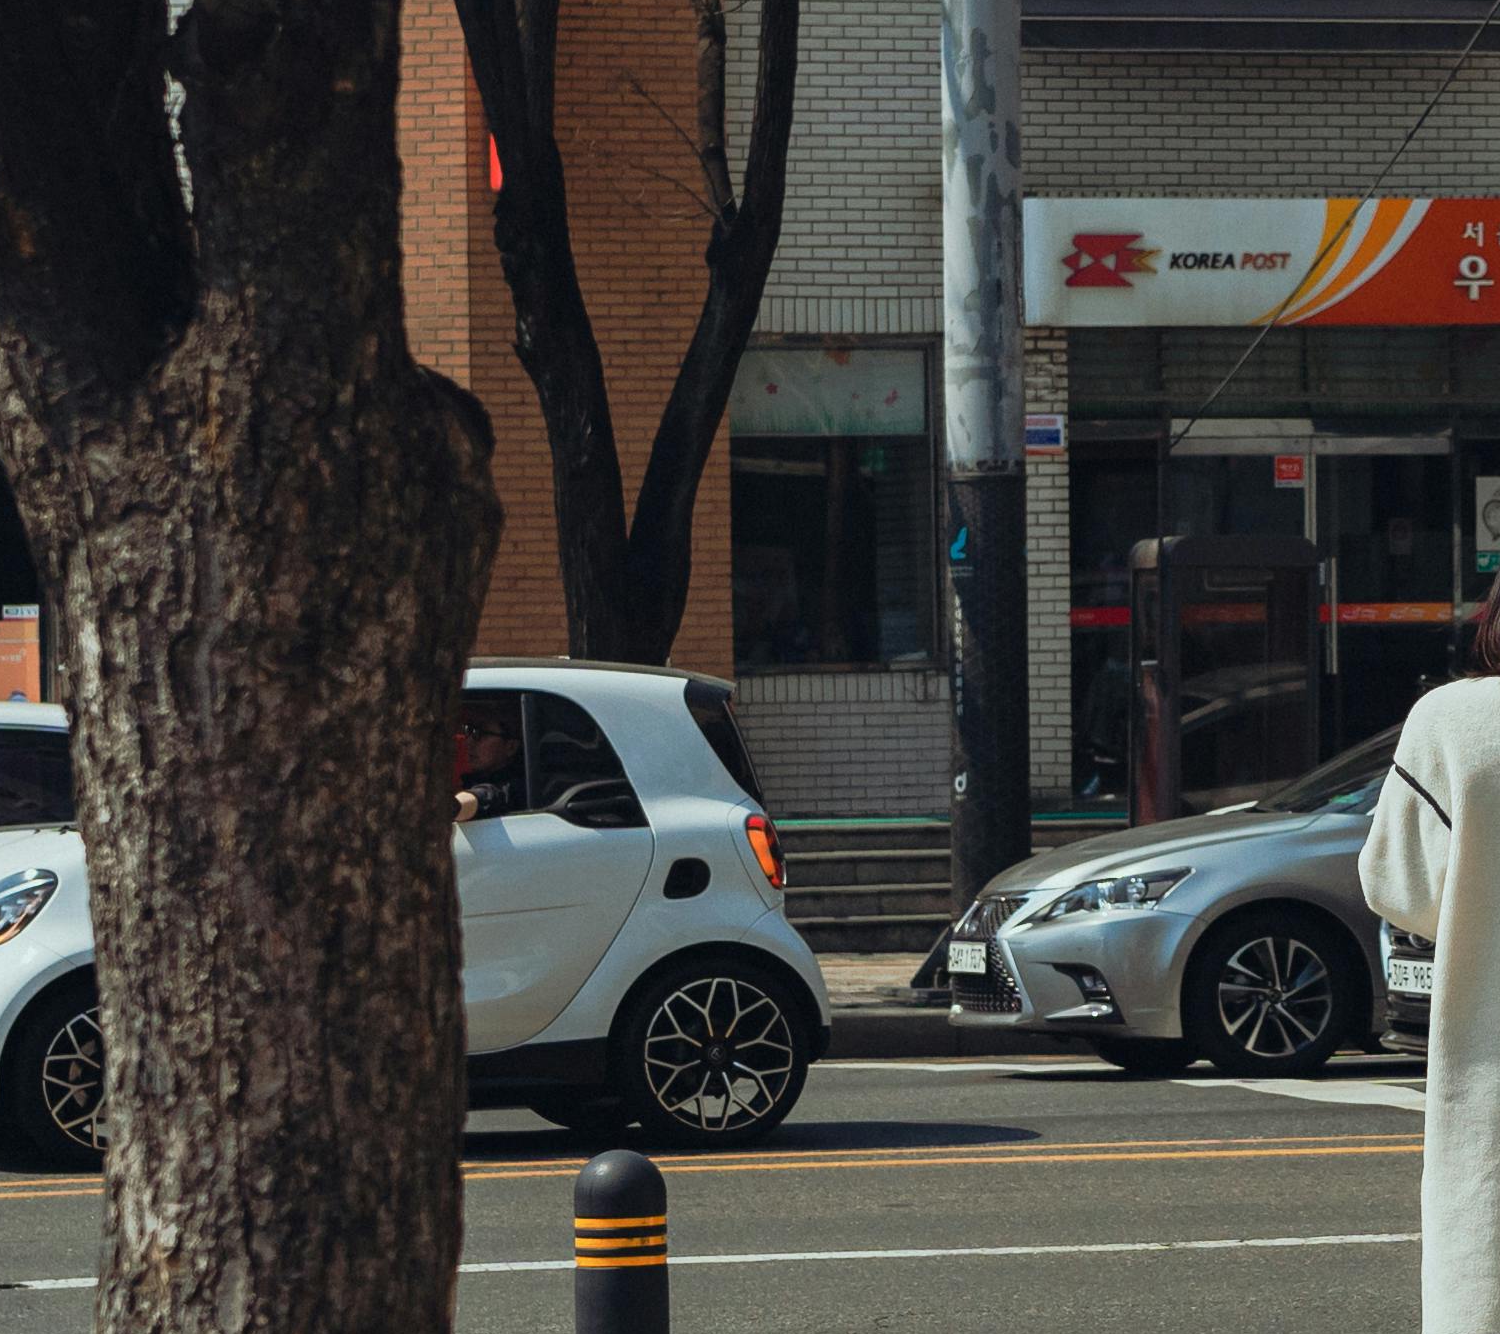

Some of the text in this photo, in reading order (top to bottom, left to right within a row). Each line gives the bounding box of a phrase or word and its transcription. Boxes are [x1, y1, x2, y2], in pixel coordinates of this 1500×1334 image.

[1169, 252, 1290, 270] KOREA POST
[1413, 965, 1432, 989] 985
